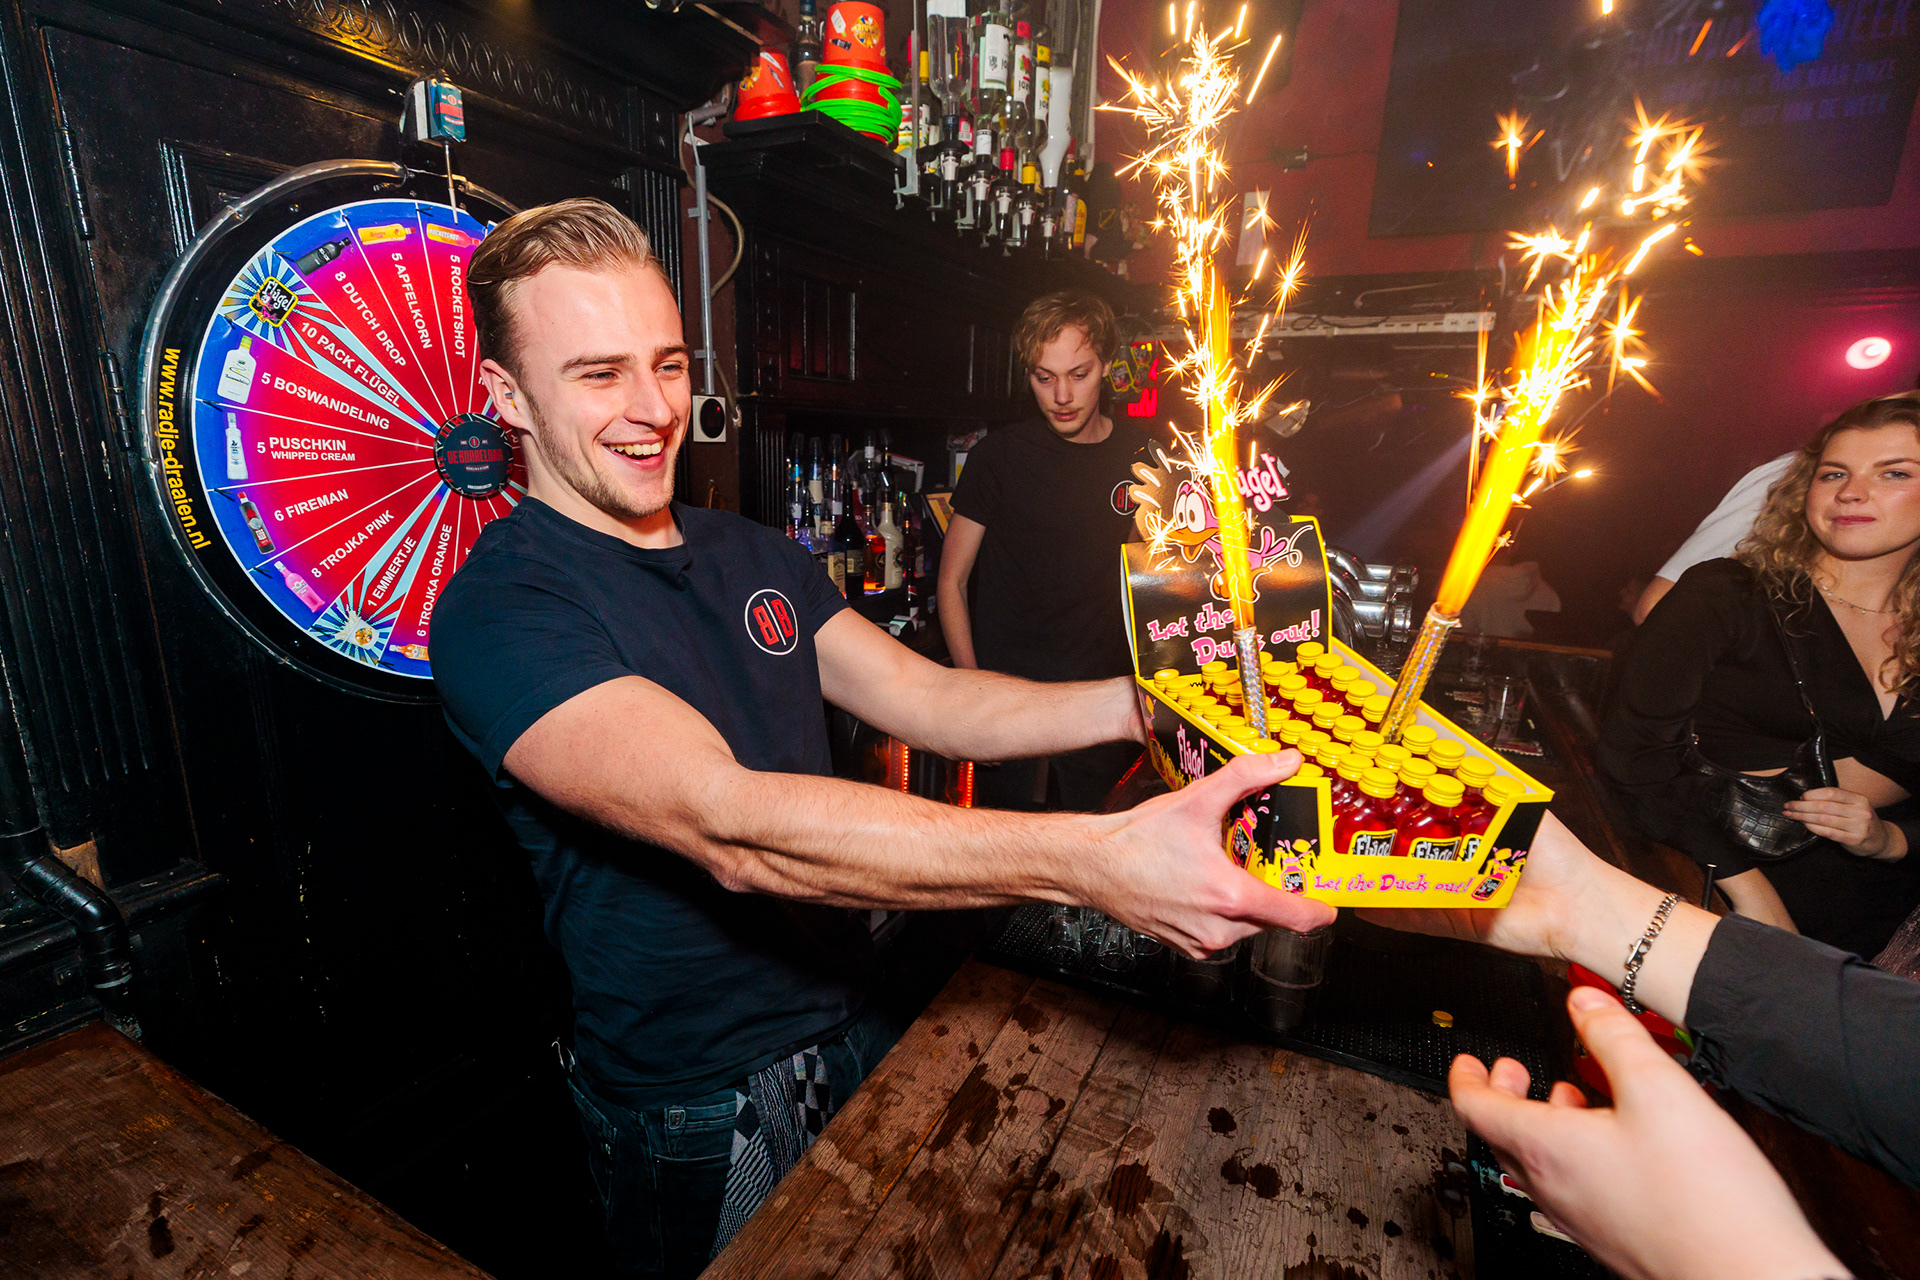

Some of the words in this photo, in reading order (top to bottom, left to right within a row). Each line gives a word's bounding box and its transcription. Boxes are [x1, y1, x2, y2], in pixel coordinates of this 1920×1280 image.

[262, 280, 294, 311] Flügel
[334, 271, 346, 282] 8
[342, 282, 380, 330] DUTCH
[376, 330, 406, 366] DROP
[394, 264, 432, 348] APFELKORN
[451, 266, 465, 358] ROCKETSHOT
[301, 322, 317, 338] 10
[317, 335, 356, 369] PACK
[354, 364, 400, 407] FLÜGEL
[261, 372, 272, 385] 5
[274, 377, 390, 430] BOSWANDELING
[154, 348, 212, 550] www.radje-draaien.nl
[257, 442, 266, 454] 5
[269, 437, 346, 451] PUSCHKIN
[271, 451, 318, 460] WHIPPED
[321, 452, 356, 461] CREAM
[447, 451, 458, 464] DE
[274, 510, 284, 522] 6
[285, 488, 349, 518] FIREMAN
[311, 567, 321, 578] 8
[320, 531, 368, 572] TROJKA
[365, 509, 394, 536] PINK
[432, 524, 453, 577] ORANGE
[367, 599, 377, 608] 1
[372, 536, 417, 600] EMMERTJE
[419, 578, 440, 626] TROJKA
[1148, 616, 1188, 641] Let
[1194, 602, 1236, 633] the
[416, 629, 426, 637] 6
[1271, 609, 1320, 644] out!
[1314, 874, 1342, 892] Let
[1346, 873, 1375, 891] the
[1380, 874, 1429, 892] Duck
[1434, 877, 1475, 894] out!
